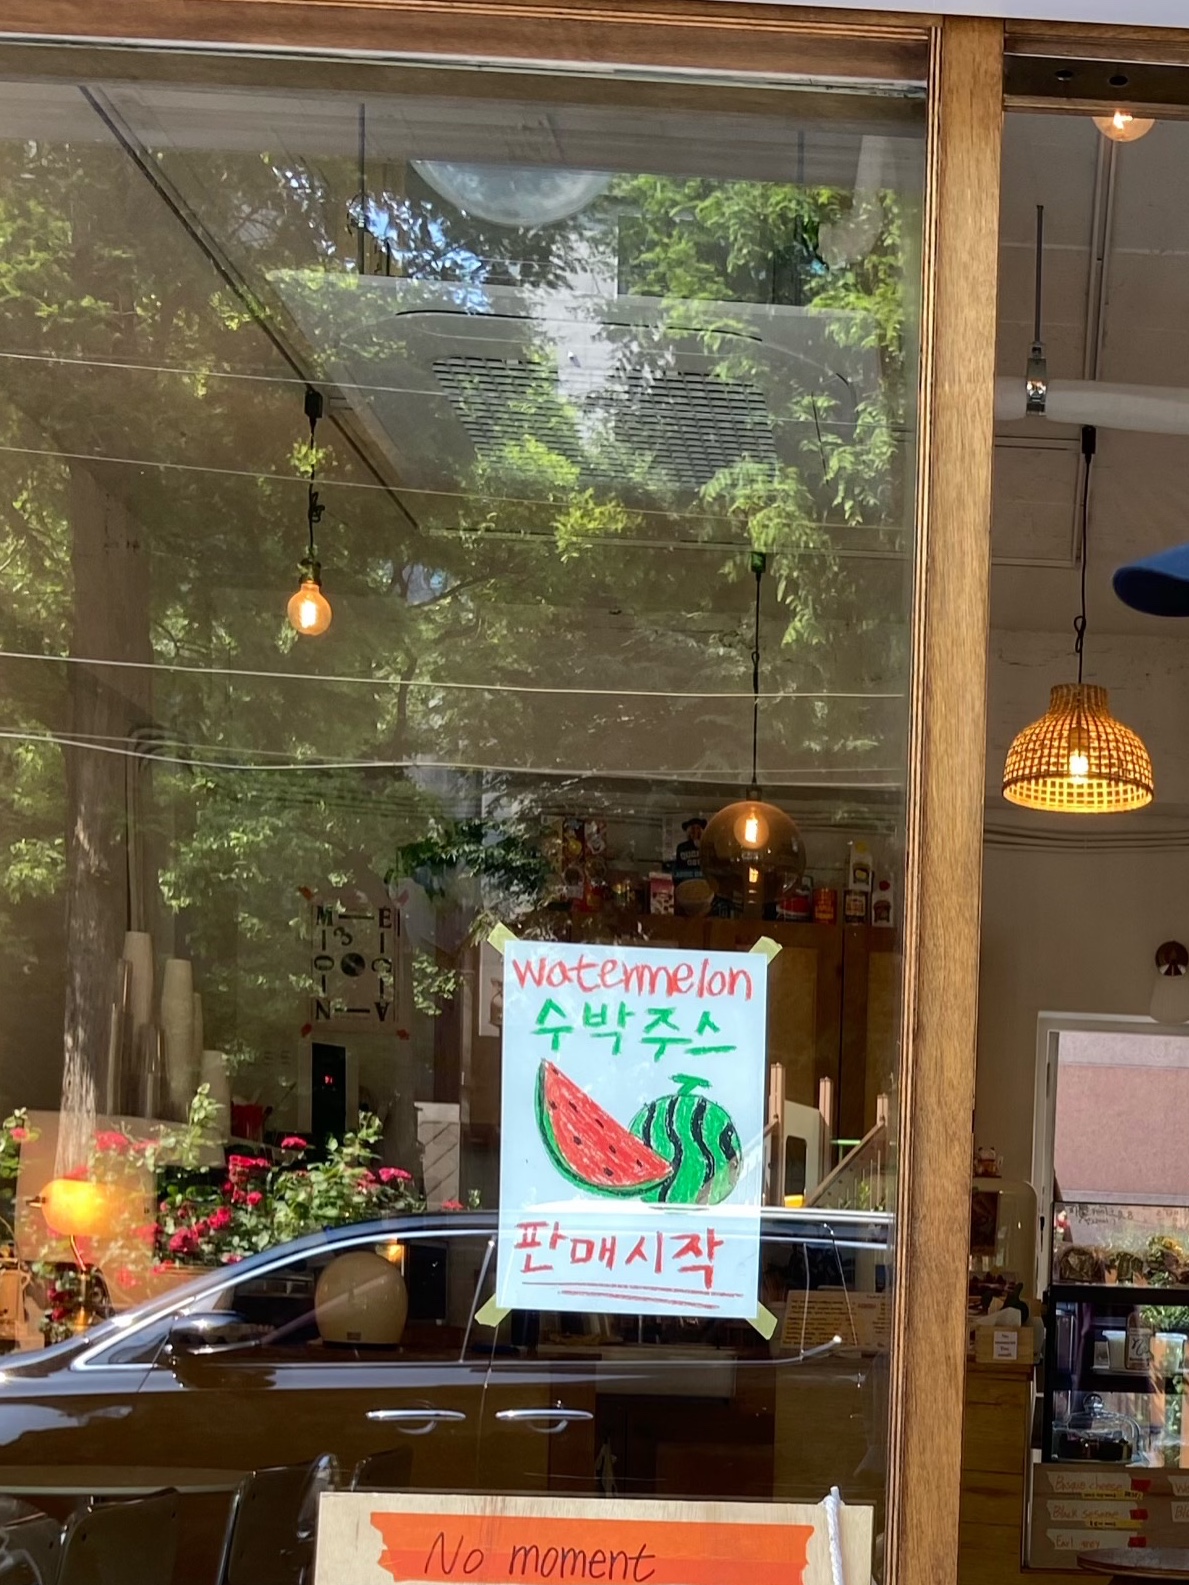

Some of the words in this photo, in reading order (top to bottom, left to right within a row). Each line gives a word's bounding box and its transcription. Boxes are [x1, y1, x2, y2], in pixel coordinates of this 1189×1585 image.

[511, 953, 753, 1003] watermelon
[530, 996, 737, 1063] 수박주스
[513, 1219, 724, 1291] 판매시작
[424, 1532, 485, 1576] No
[508, 1543, 656, 1584] moment
